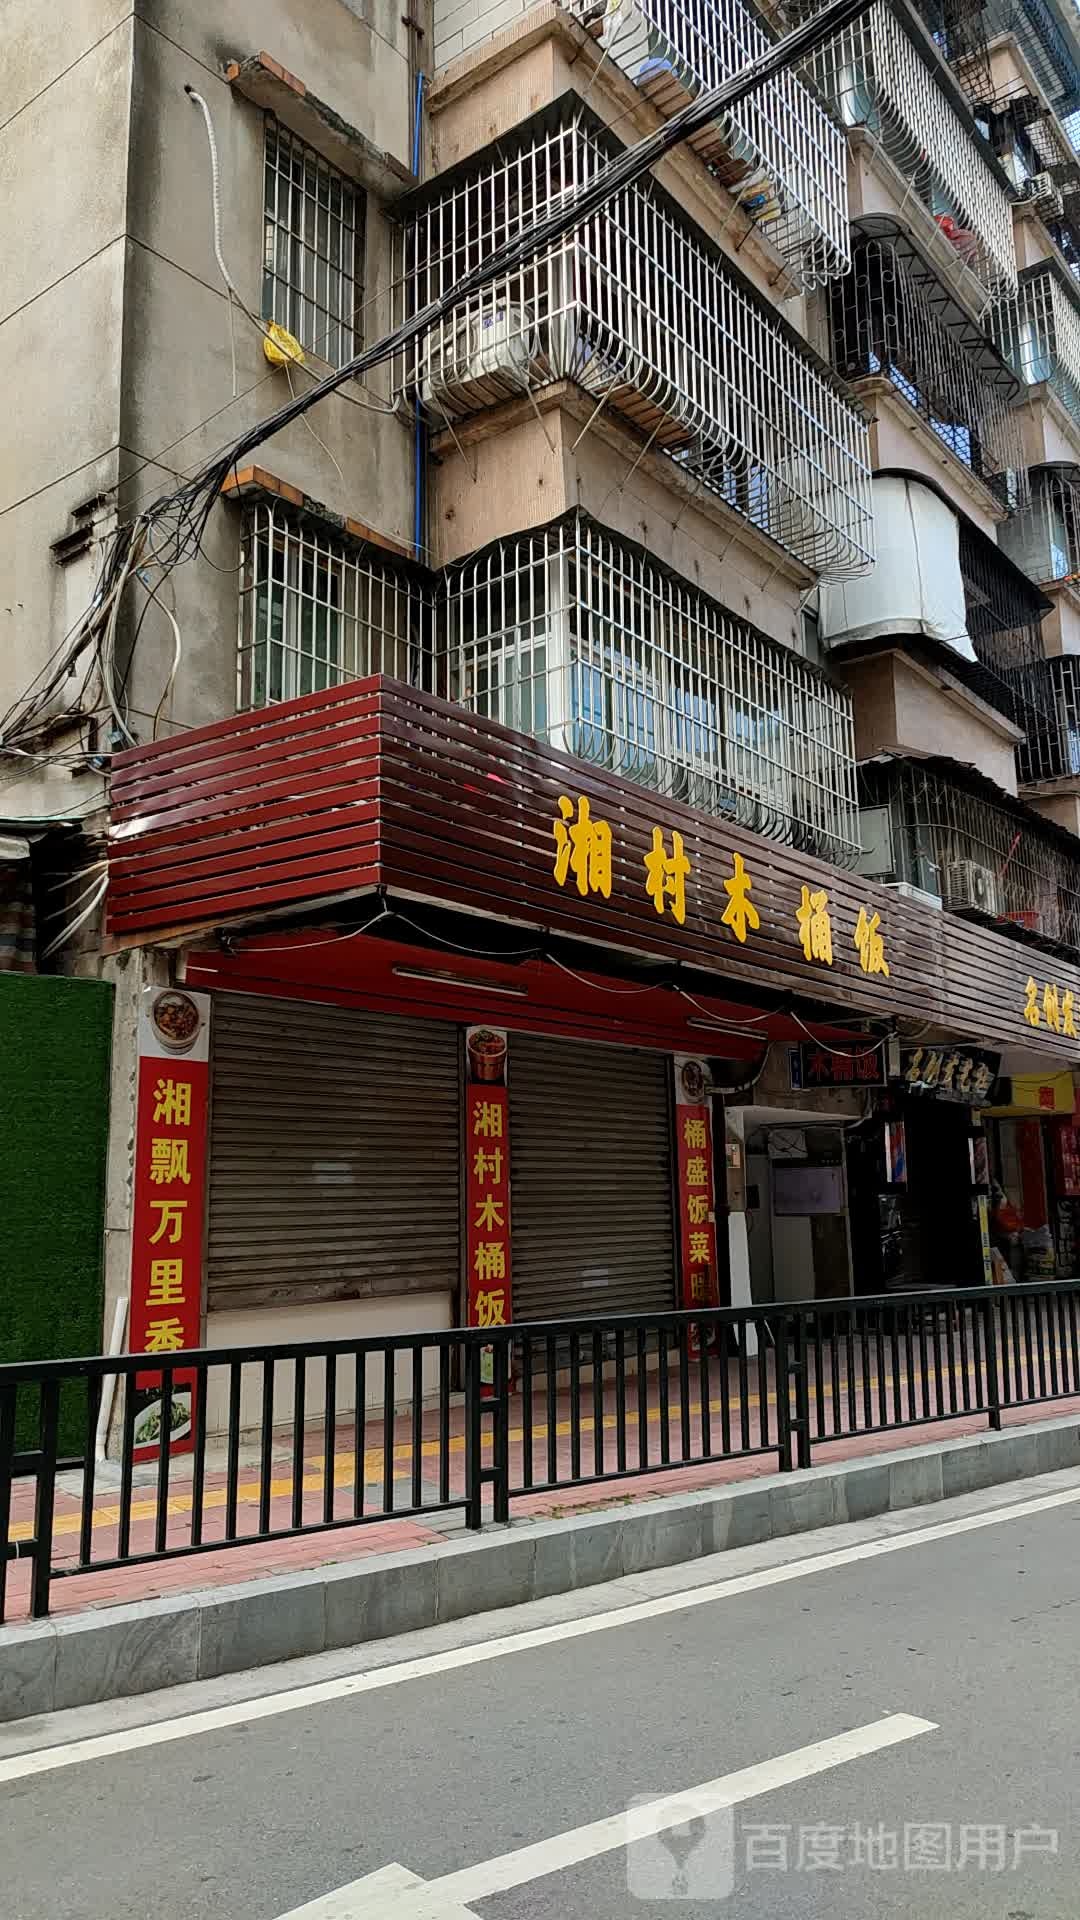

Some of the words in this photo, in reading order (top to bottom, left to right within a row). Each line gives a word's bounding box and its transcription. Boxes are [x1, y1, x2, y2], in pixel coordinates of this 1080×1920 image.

[552, 794, 890, 978] 湘村木桶饭
[145, 1078, 192, 1352] 湘飘万里香
[472, 1100, 507, 1328] 湘村木桶饭
